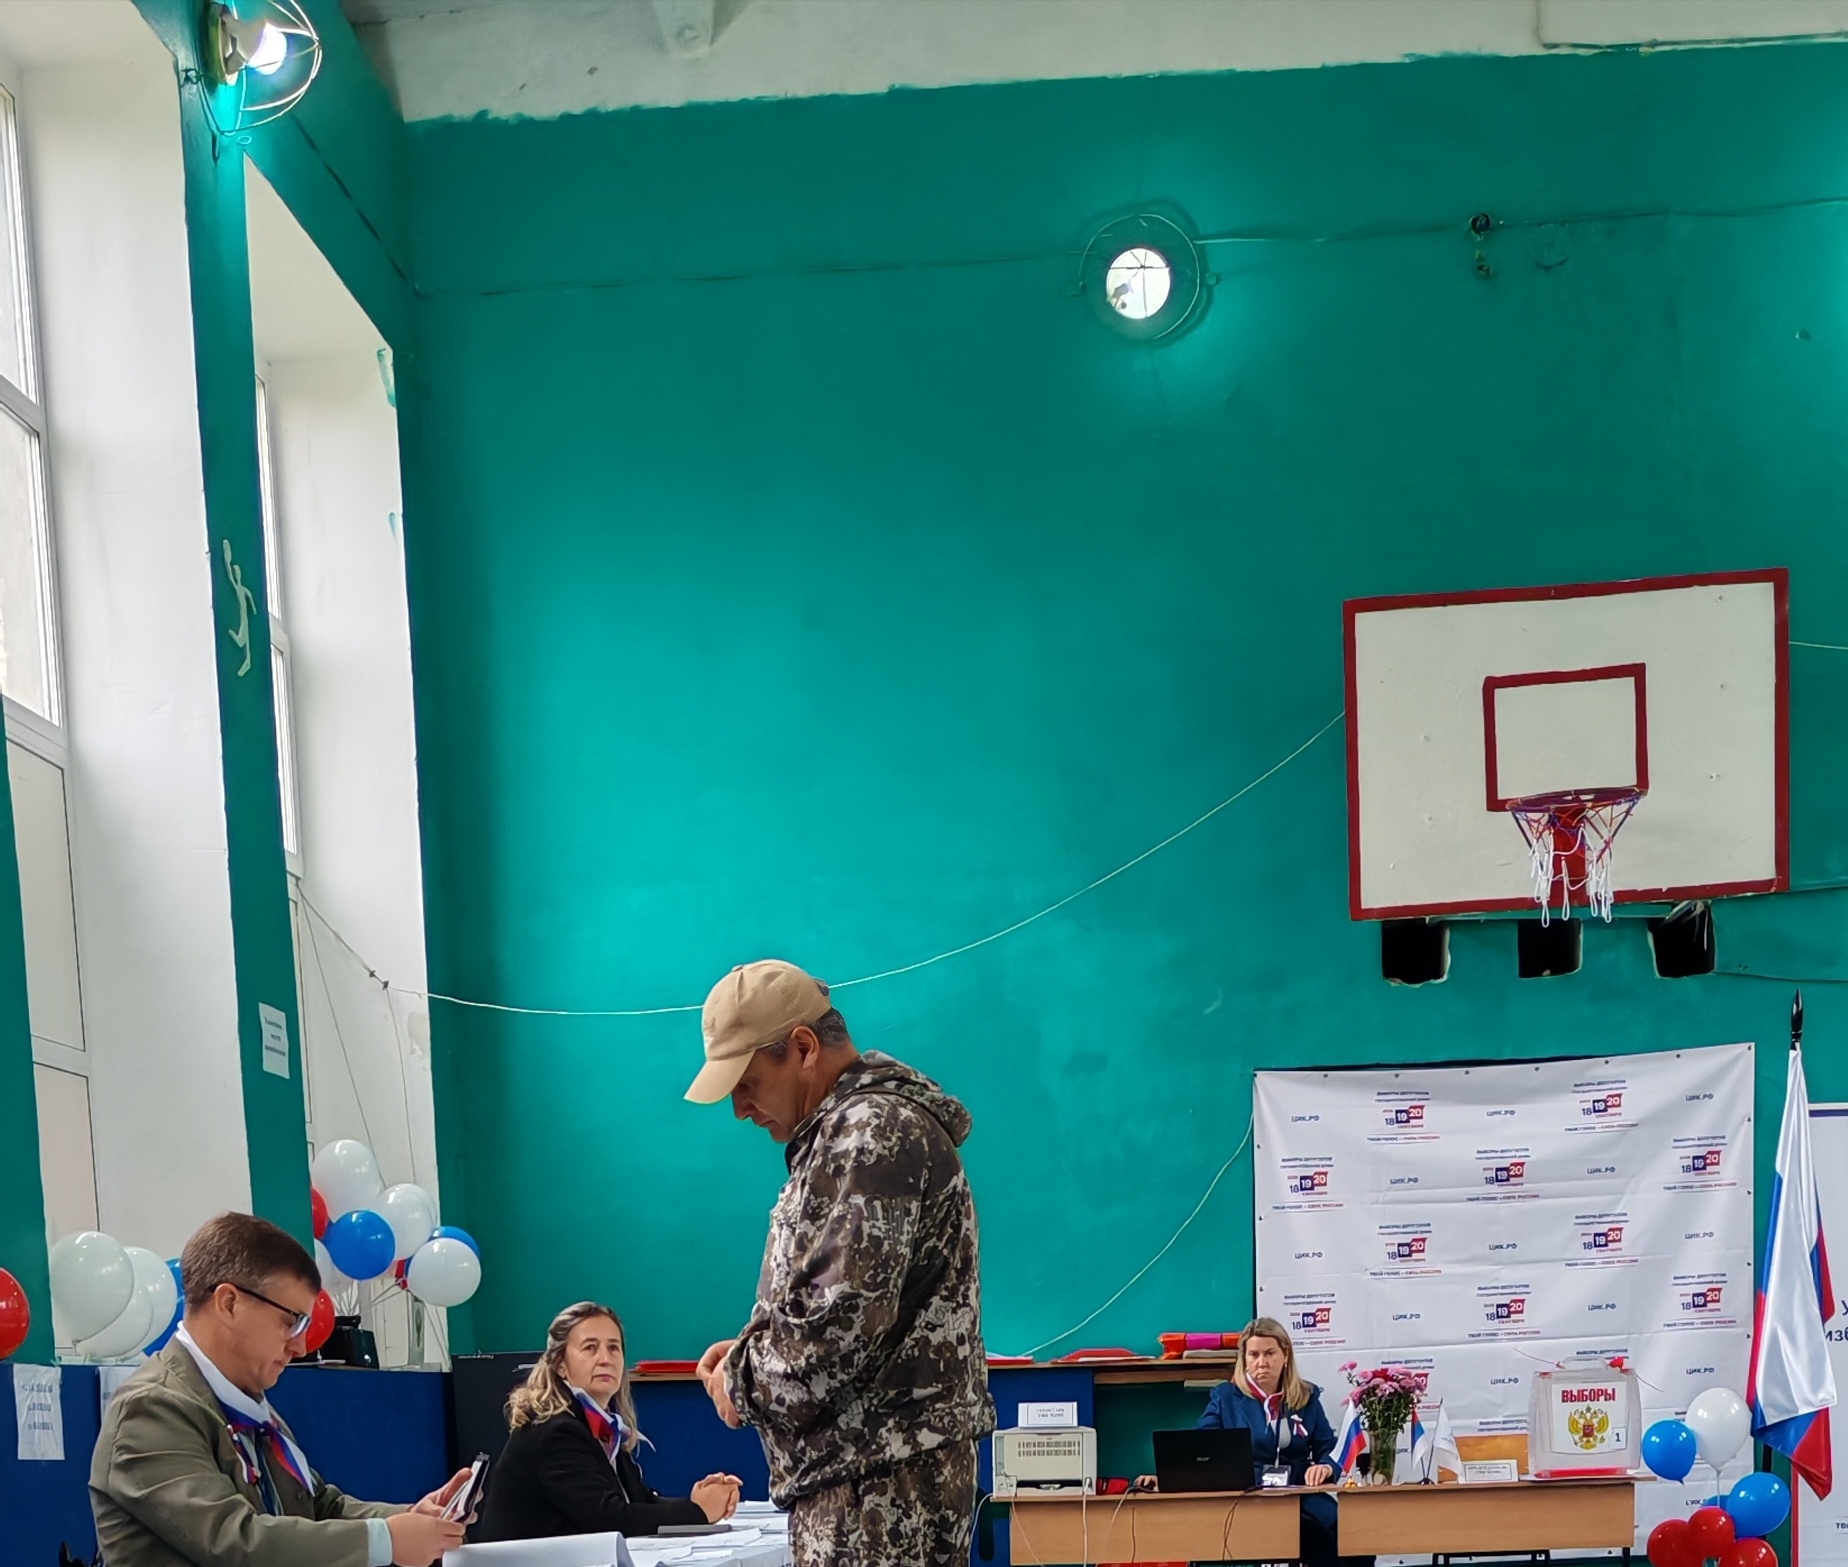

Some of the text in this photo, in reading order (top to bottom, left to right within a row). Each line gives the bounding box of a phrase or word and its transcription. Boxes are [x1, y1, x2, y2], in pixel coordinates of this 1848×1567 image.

[1581, 1096, 1620, 1116] 18 19 20
[1385, 1108, 1422, 1126] 18 19 20
[1681, 1153, 1719, 1174] 18 19 20
[1289, 1174, 1327, 1194] 18 19 20
[1484, 1166, 1523, 1185] 18 19 20
[1582, 1230, 1621, 1250] 18 19 20
[1387, 1241, 1424, 1260] 18 19 20
[1681, 1291, 1720, 1311] 18 19 20
[1291, 1311, 1329, 1330] 18 19 20
[1485, 1302, 1523, 1321] 18 19 20
[1561, 1387, 1616, 1404] ВЫБОРЫ
[1614, 1432, 1621, 1443] 1
